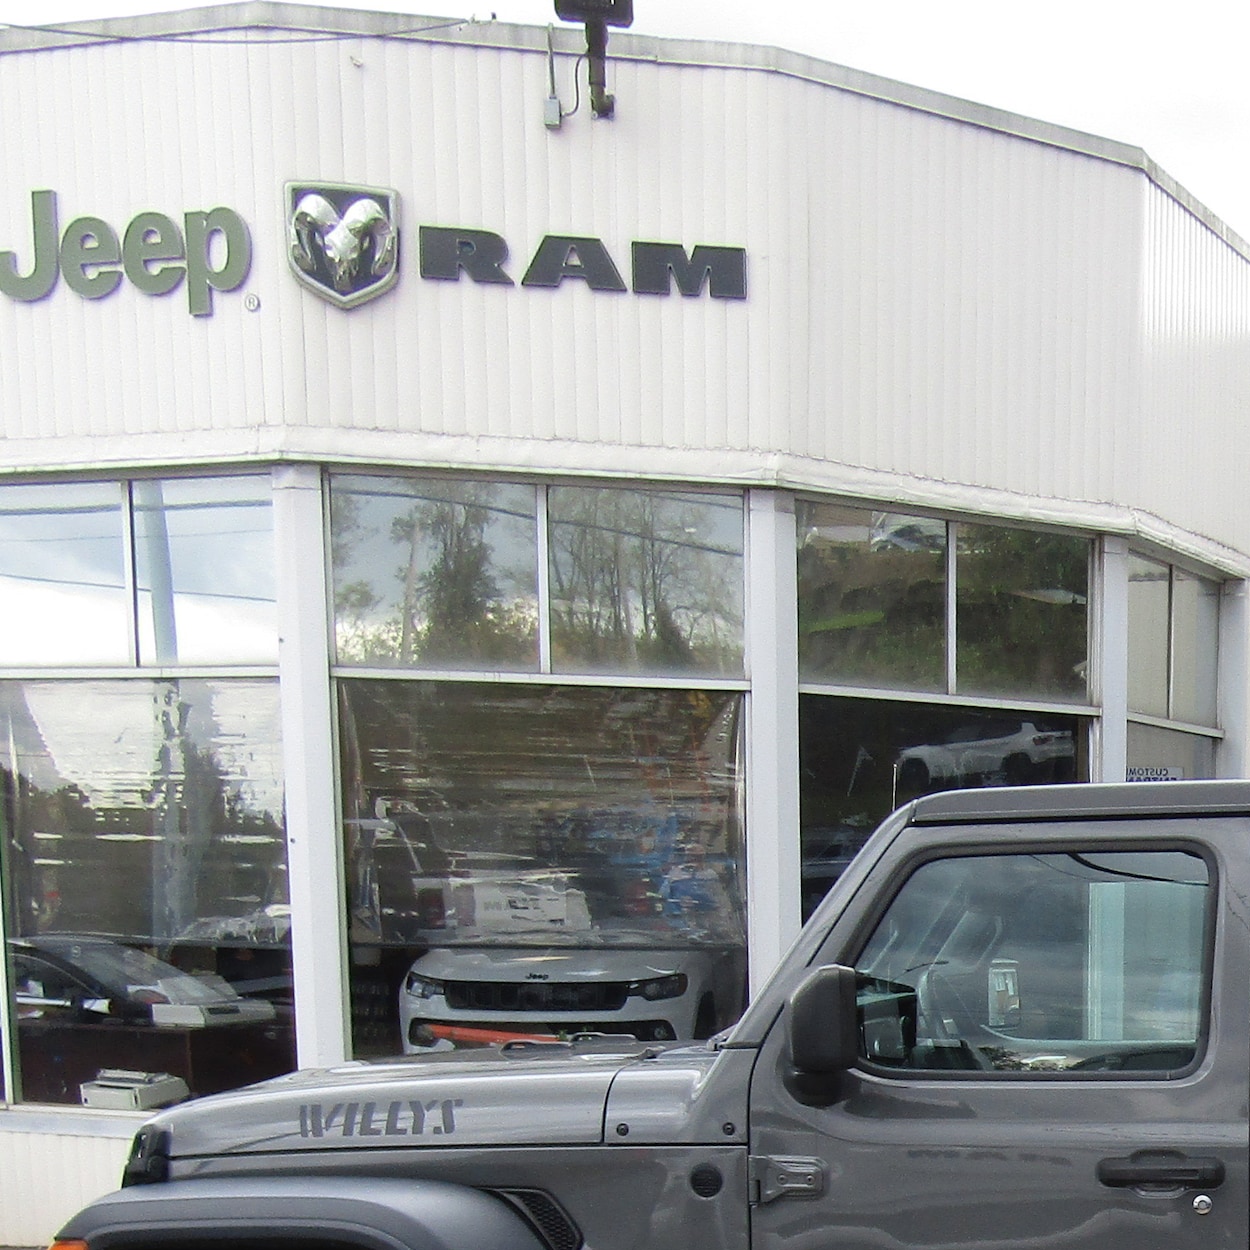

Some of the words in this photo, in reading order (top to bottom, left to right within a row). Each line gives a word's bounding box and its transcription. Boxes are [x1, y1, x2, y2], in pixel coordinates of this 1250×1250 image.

[0, 189, 254, 317] Jeep
[419, 225, 748, 299] RAM
[524, 972, 550, 981] Jeep
[299, 1099, 465, 1139] WILLYS
